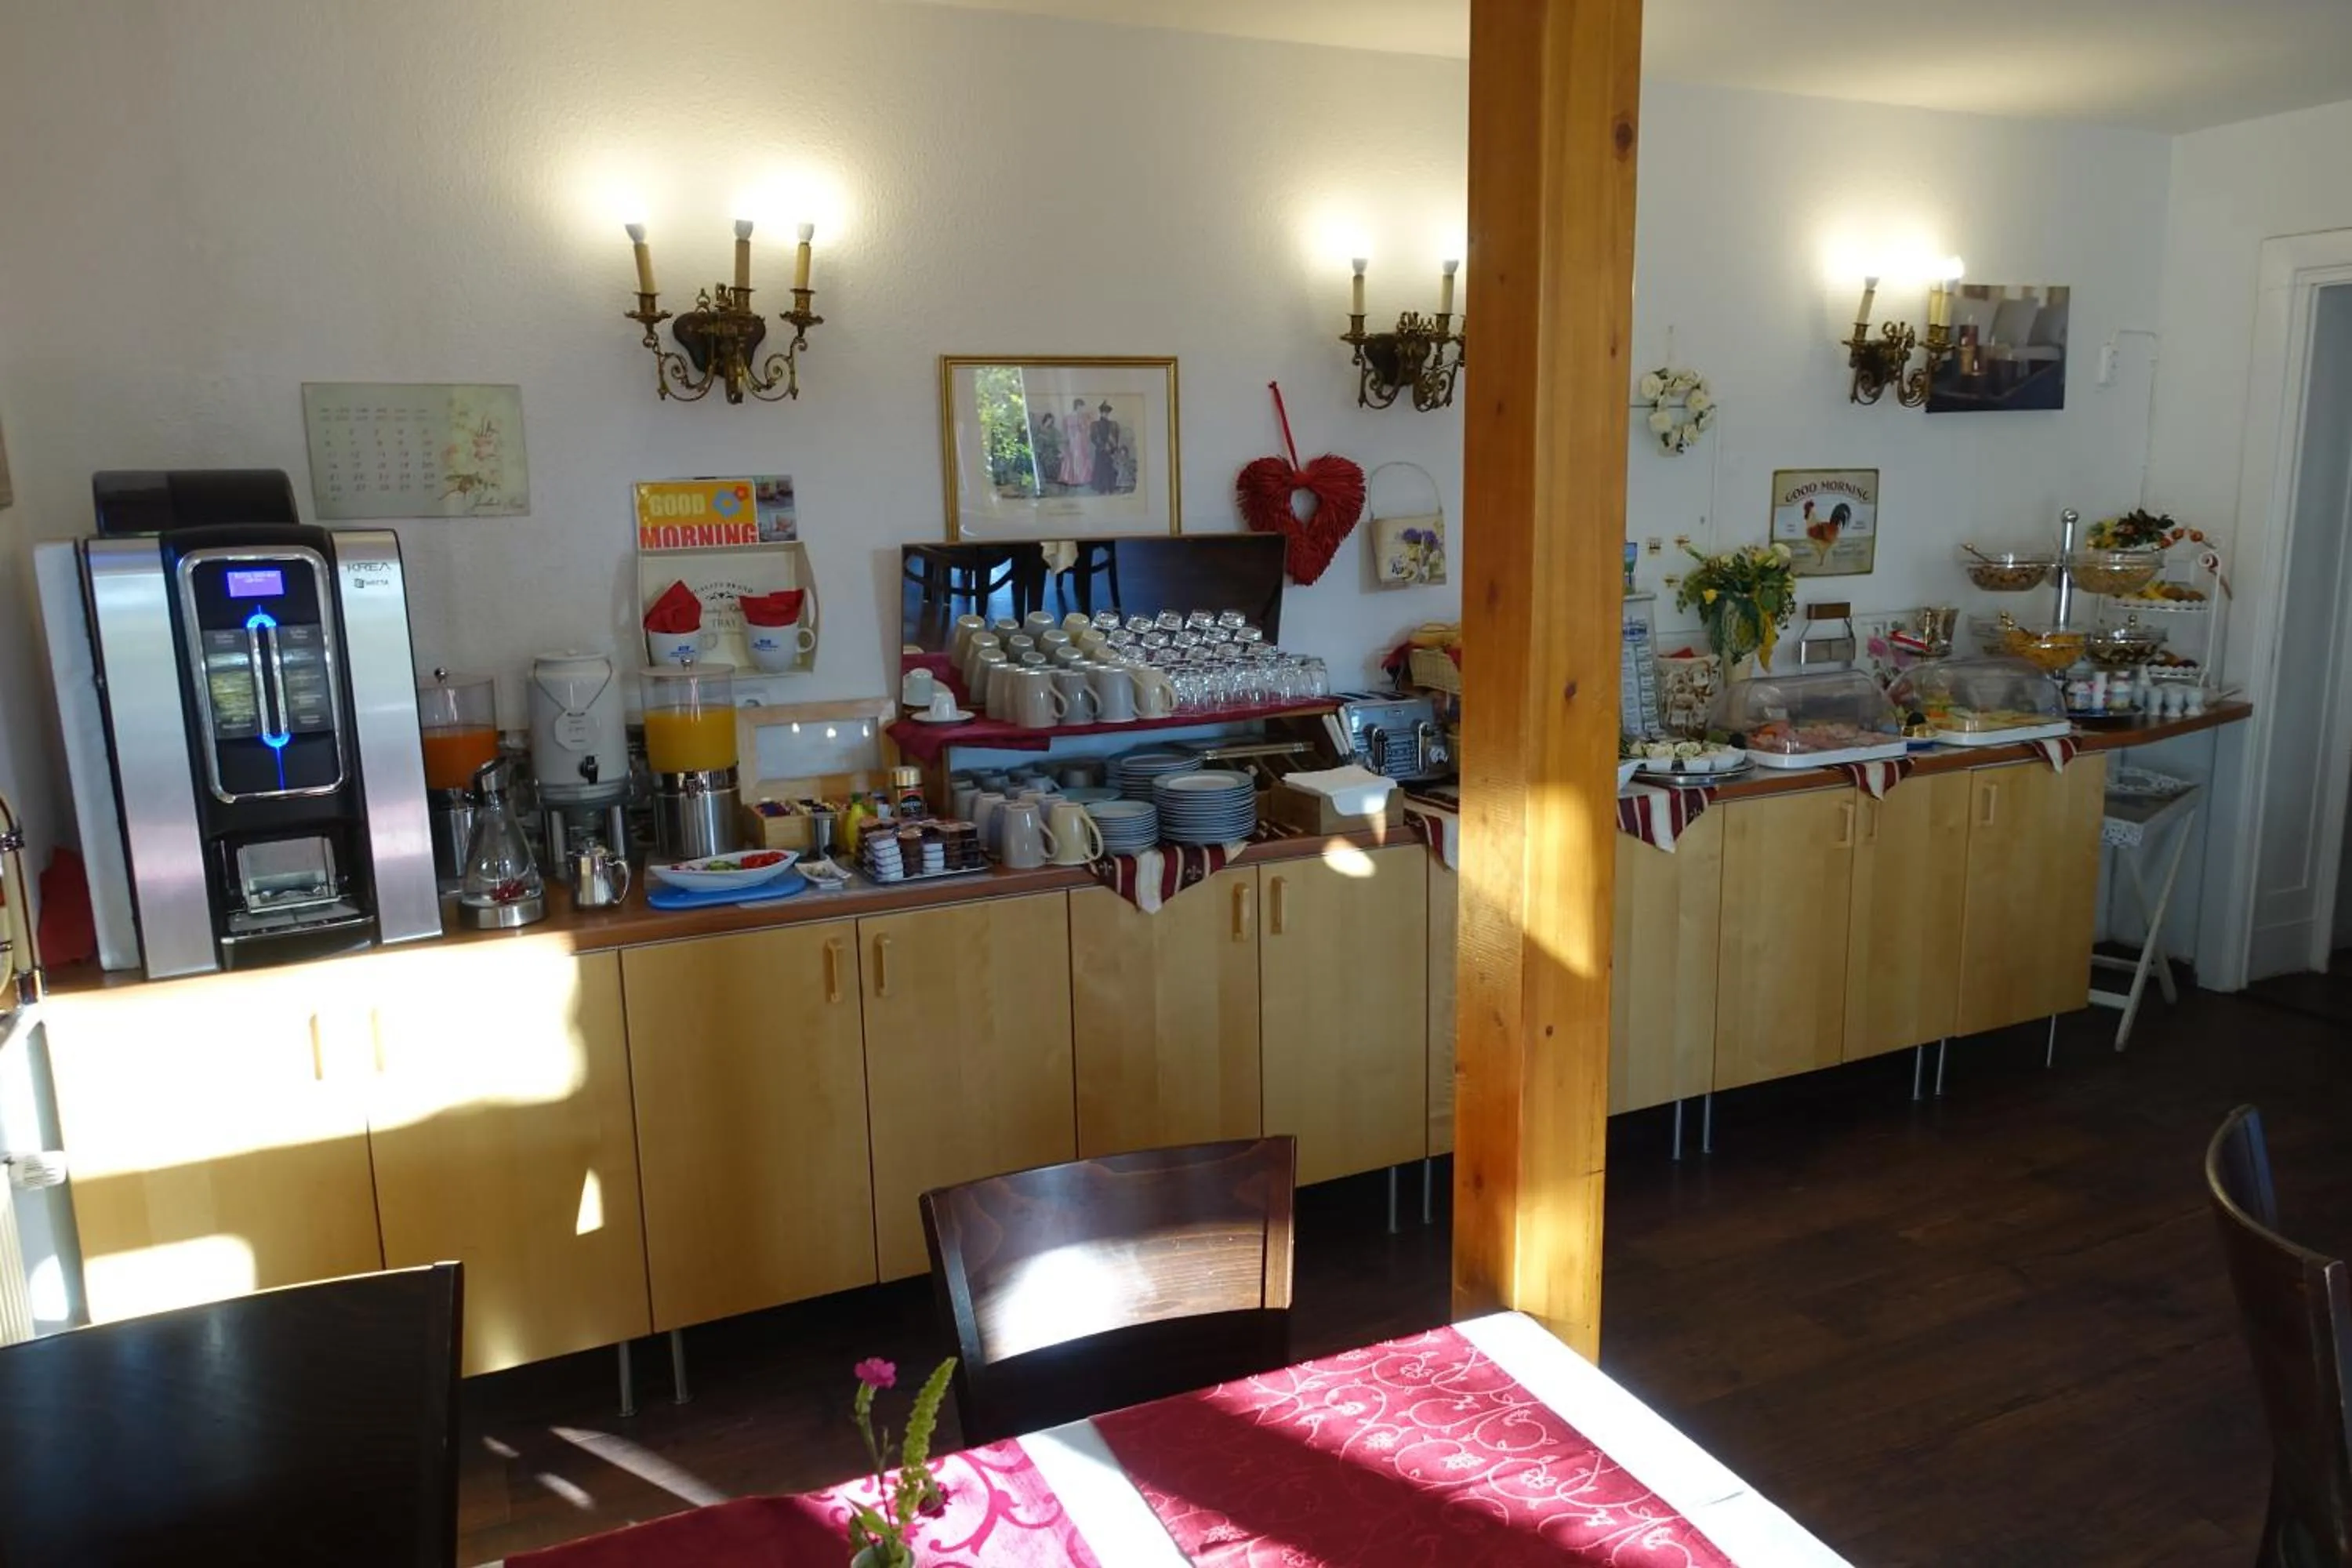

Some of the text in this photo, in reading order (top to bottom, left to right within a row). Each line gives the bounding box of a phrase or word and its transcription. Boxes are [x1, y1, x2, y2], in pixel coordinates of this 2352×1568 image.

[1785, 480, 1870, 503] GOOD MORNING
[649, 493, 706, 517] GOOD
[641, 524, 757, 549] MORNING
